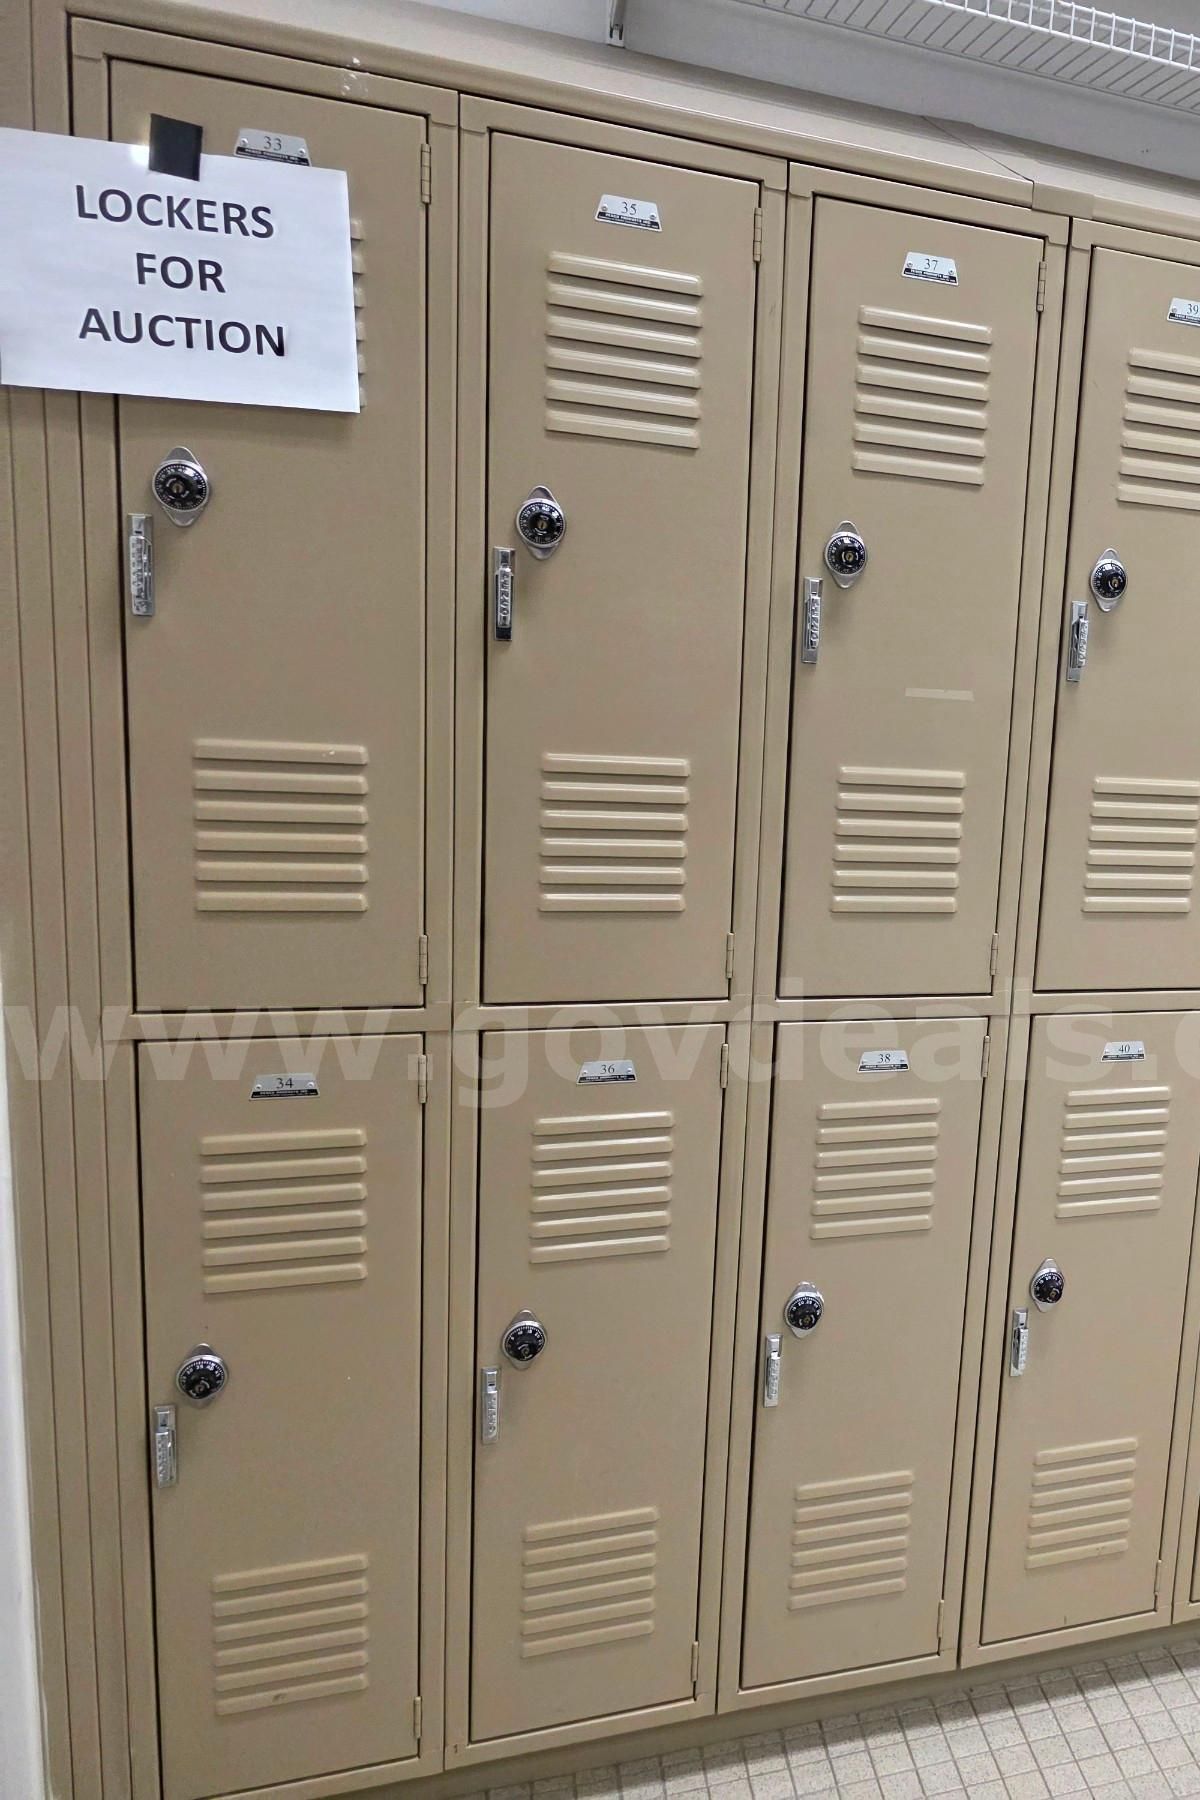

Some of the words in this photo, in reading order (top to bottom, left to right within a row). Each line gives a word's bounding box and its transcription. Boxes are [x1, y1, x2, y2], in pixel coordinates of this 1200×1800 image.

[263, 135, 282, 151] 33
[75, 184, 274, 239] LOCKERS
[621, 201, 637, 216] 35
[924, 258, 939, 271] 37
[135, 252, 226, 293] FOR
[1186, 303, 1199, 315] 39
[79, 307, 286, 358] AUCTION
[1118, 1044, 1130, 1053] 40
[878, 1053, 891, 1063] 38
[600, 1064, 615, 1074] 36
[276, 1077, 294, 1089] 34
